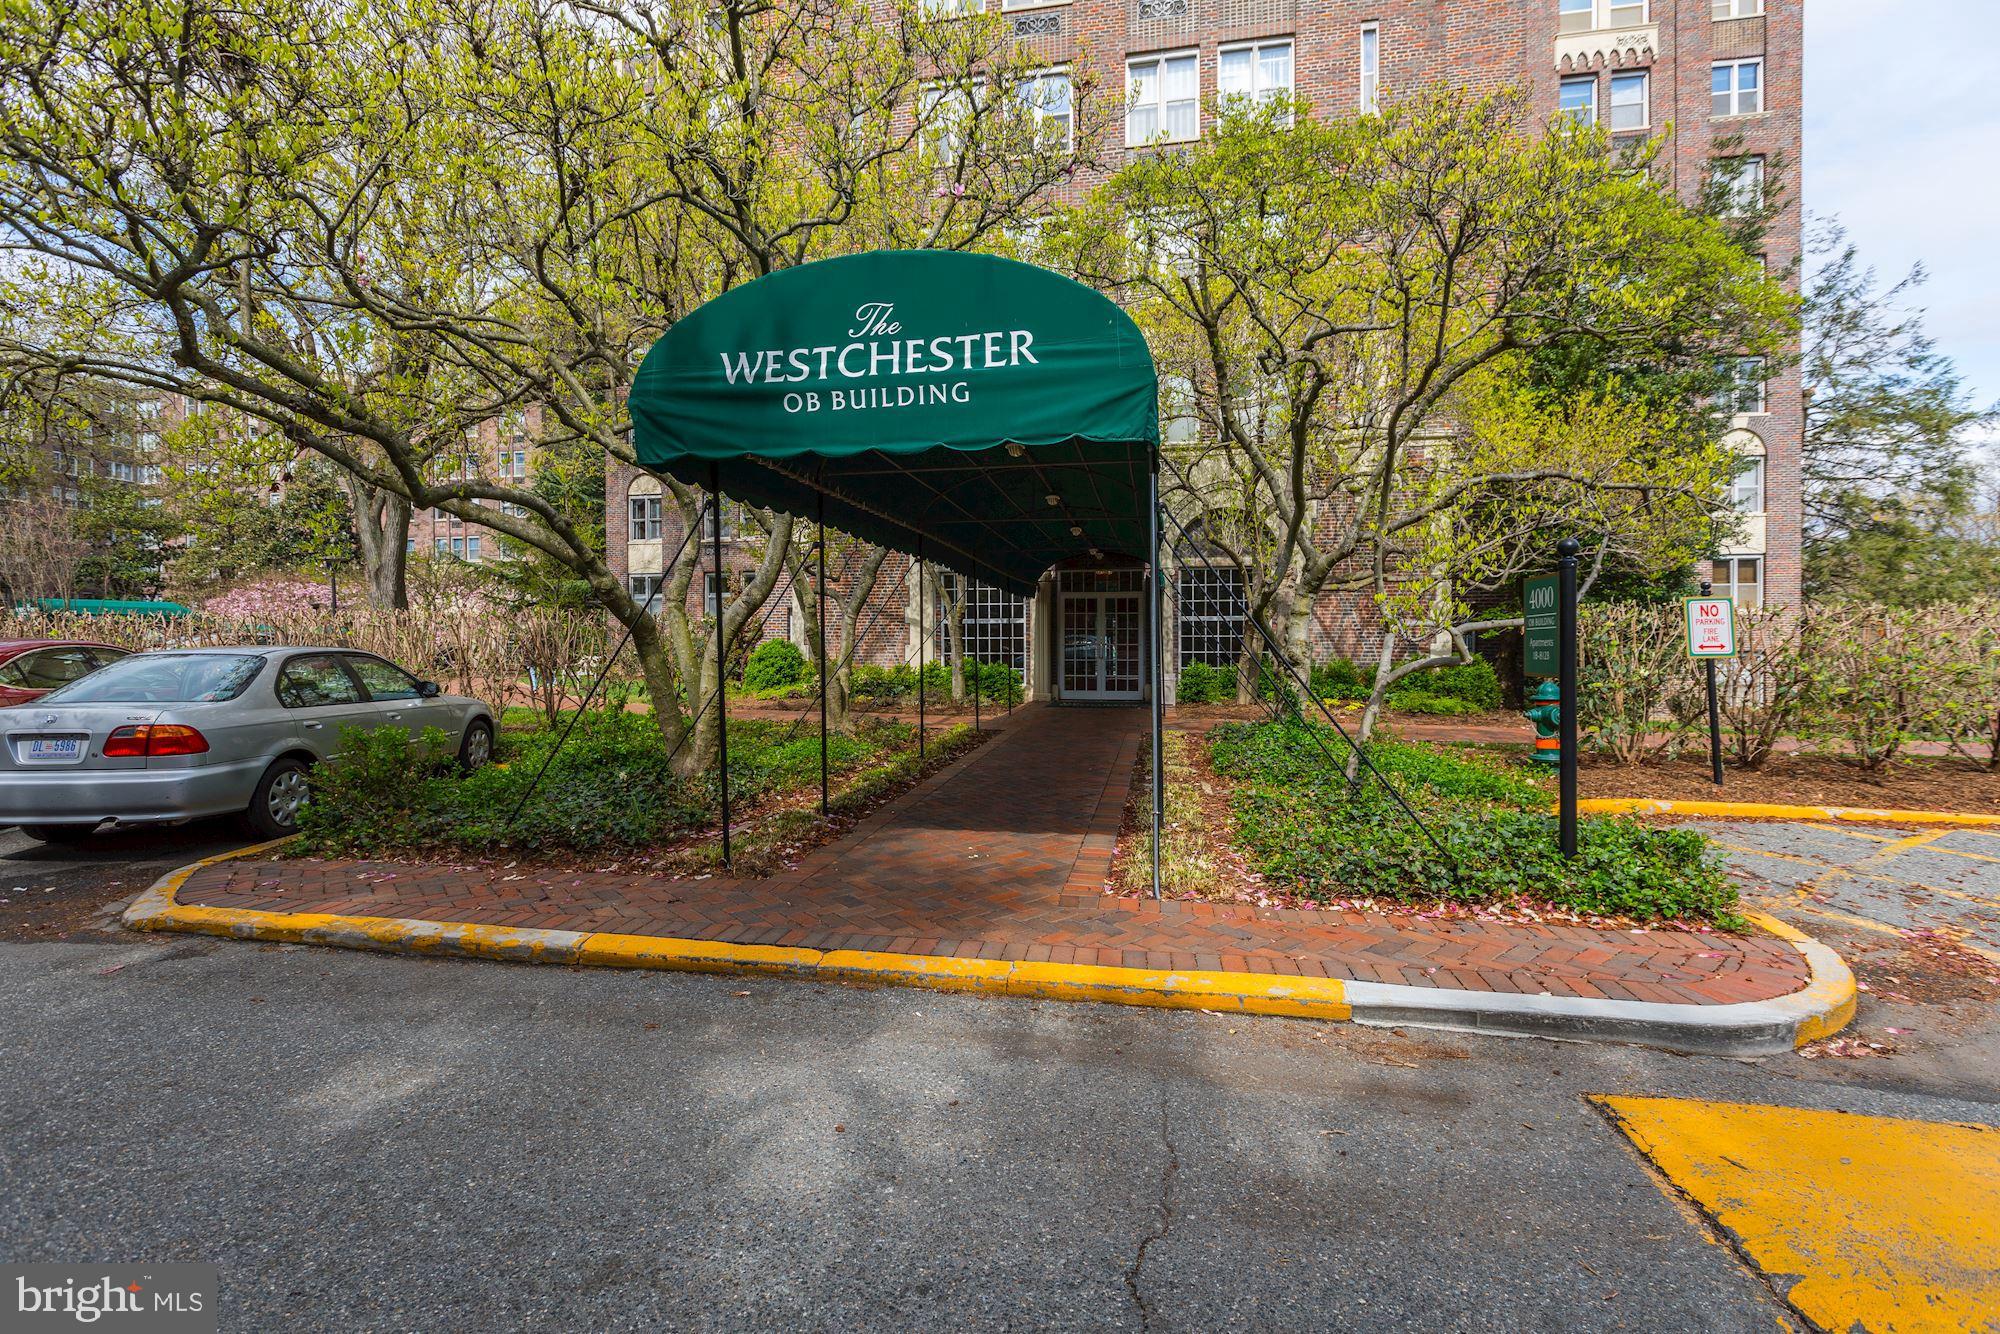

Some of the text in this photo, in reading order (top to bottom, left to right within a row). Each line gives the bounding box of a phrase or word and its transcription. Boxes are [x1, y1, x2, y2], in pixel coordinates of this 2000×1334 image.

[848, 302, 902, 338] The
[720, 330, 1040, 385] WESTCHESTER
[783, 381, 970, 414] OB BUILDING
[1529, 586, 1554, 609] 4000
[1699, 604, 1719, 617] NO
[1535, 616, 1555, 627] BUILDING
[1703, 627, 1719, 635] FIRE
[1529, 637, 1554, 649] Apartments
[1703, 635, 1721, 643] LANE
[32, 740, 77, 752] DL 5986
